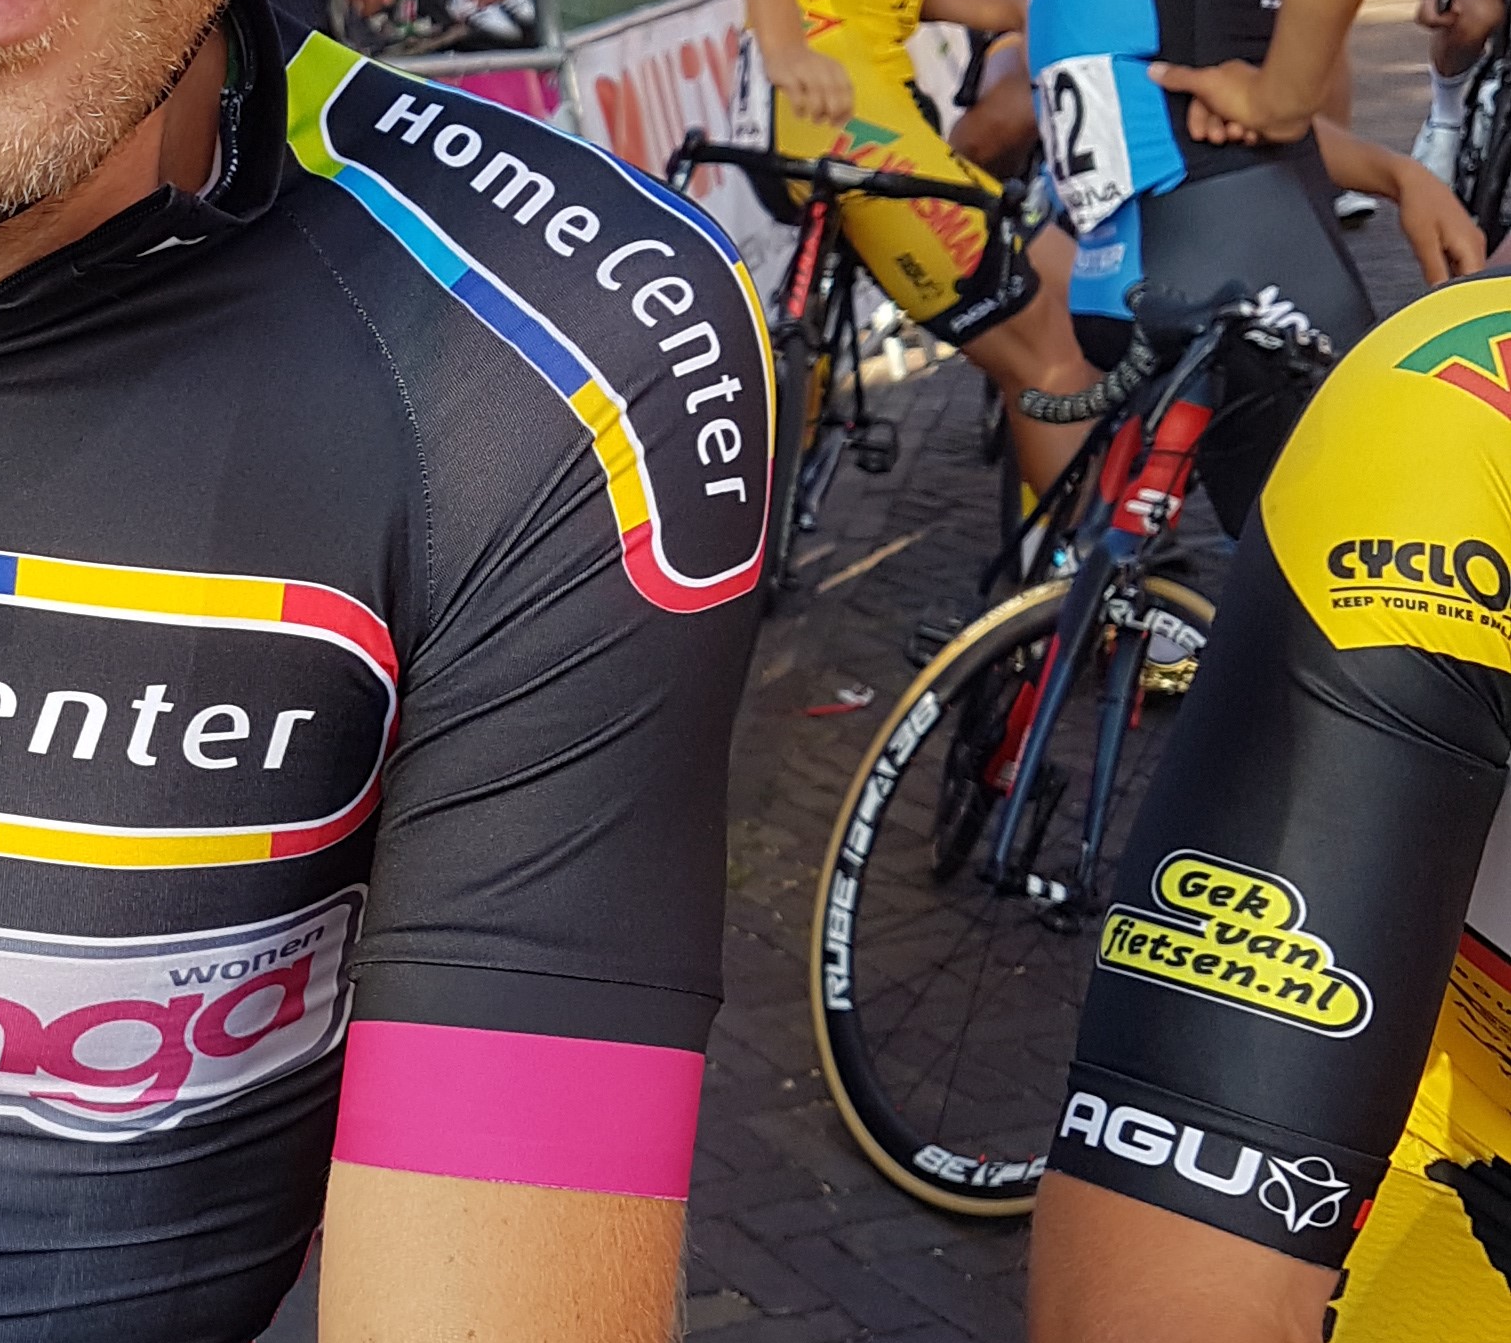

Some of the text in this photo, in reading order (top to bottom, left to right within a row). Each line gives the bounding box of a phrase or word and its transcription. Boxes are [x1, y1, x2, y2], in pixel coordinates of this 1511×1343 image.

[1044, 69, 1097, 180] 2
[374, 93, 600, 258] Home
[595, 239, 747, 504] Center
[1328, 539, 1511, 612] CYCLO
[1332, 596, 1374, 609] KEEP
[1381, 596, 1429, 612] YOUR
[1437, 604, 1474, 622] BIKE
[1178, 870, 1271, 920] Gek
[169, 924, 325, 988] wonen
[1103, 918, 1344, 1012] fietsen.nl
[1214, 921, 1320, 971] van
[1059, 1091, 1263, 1196] AGU
